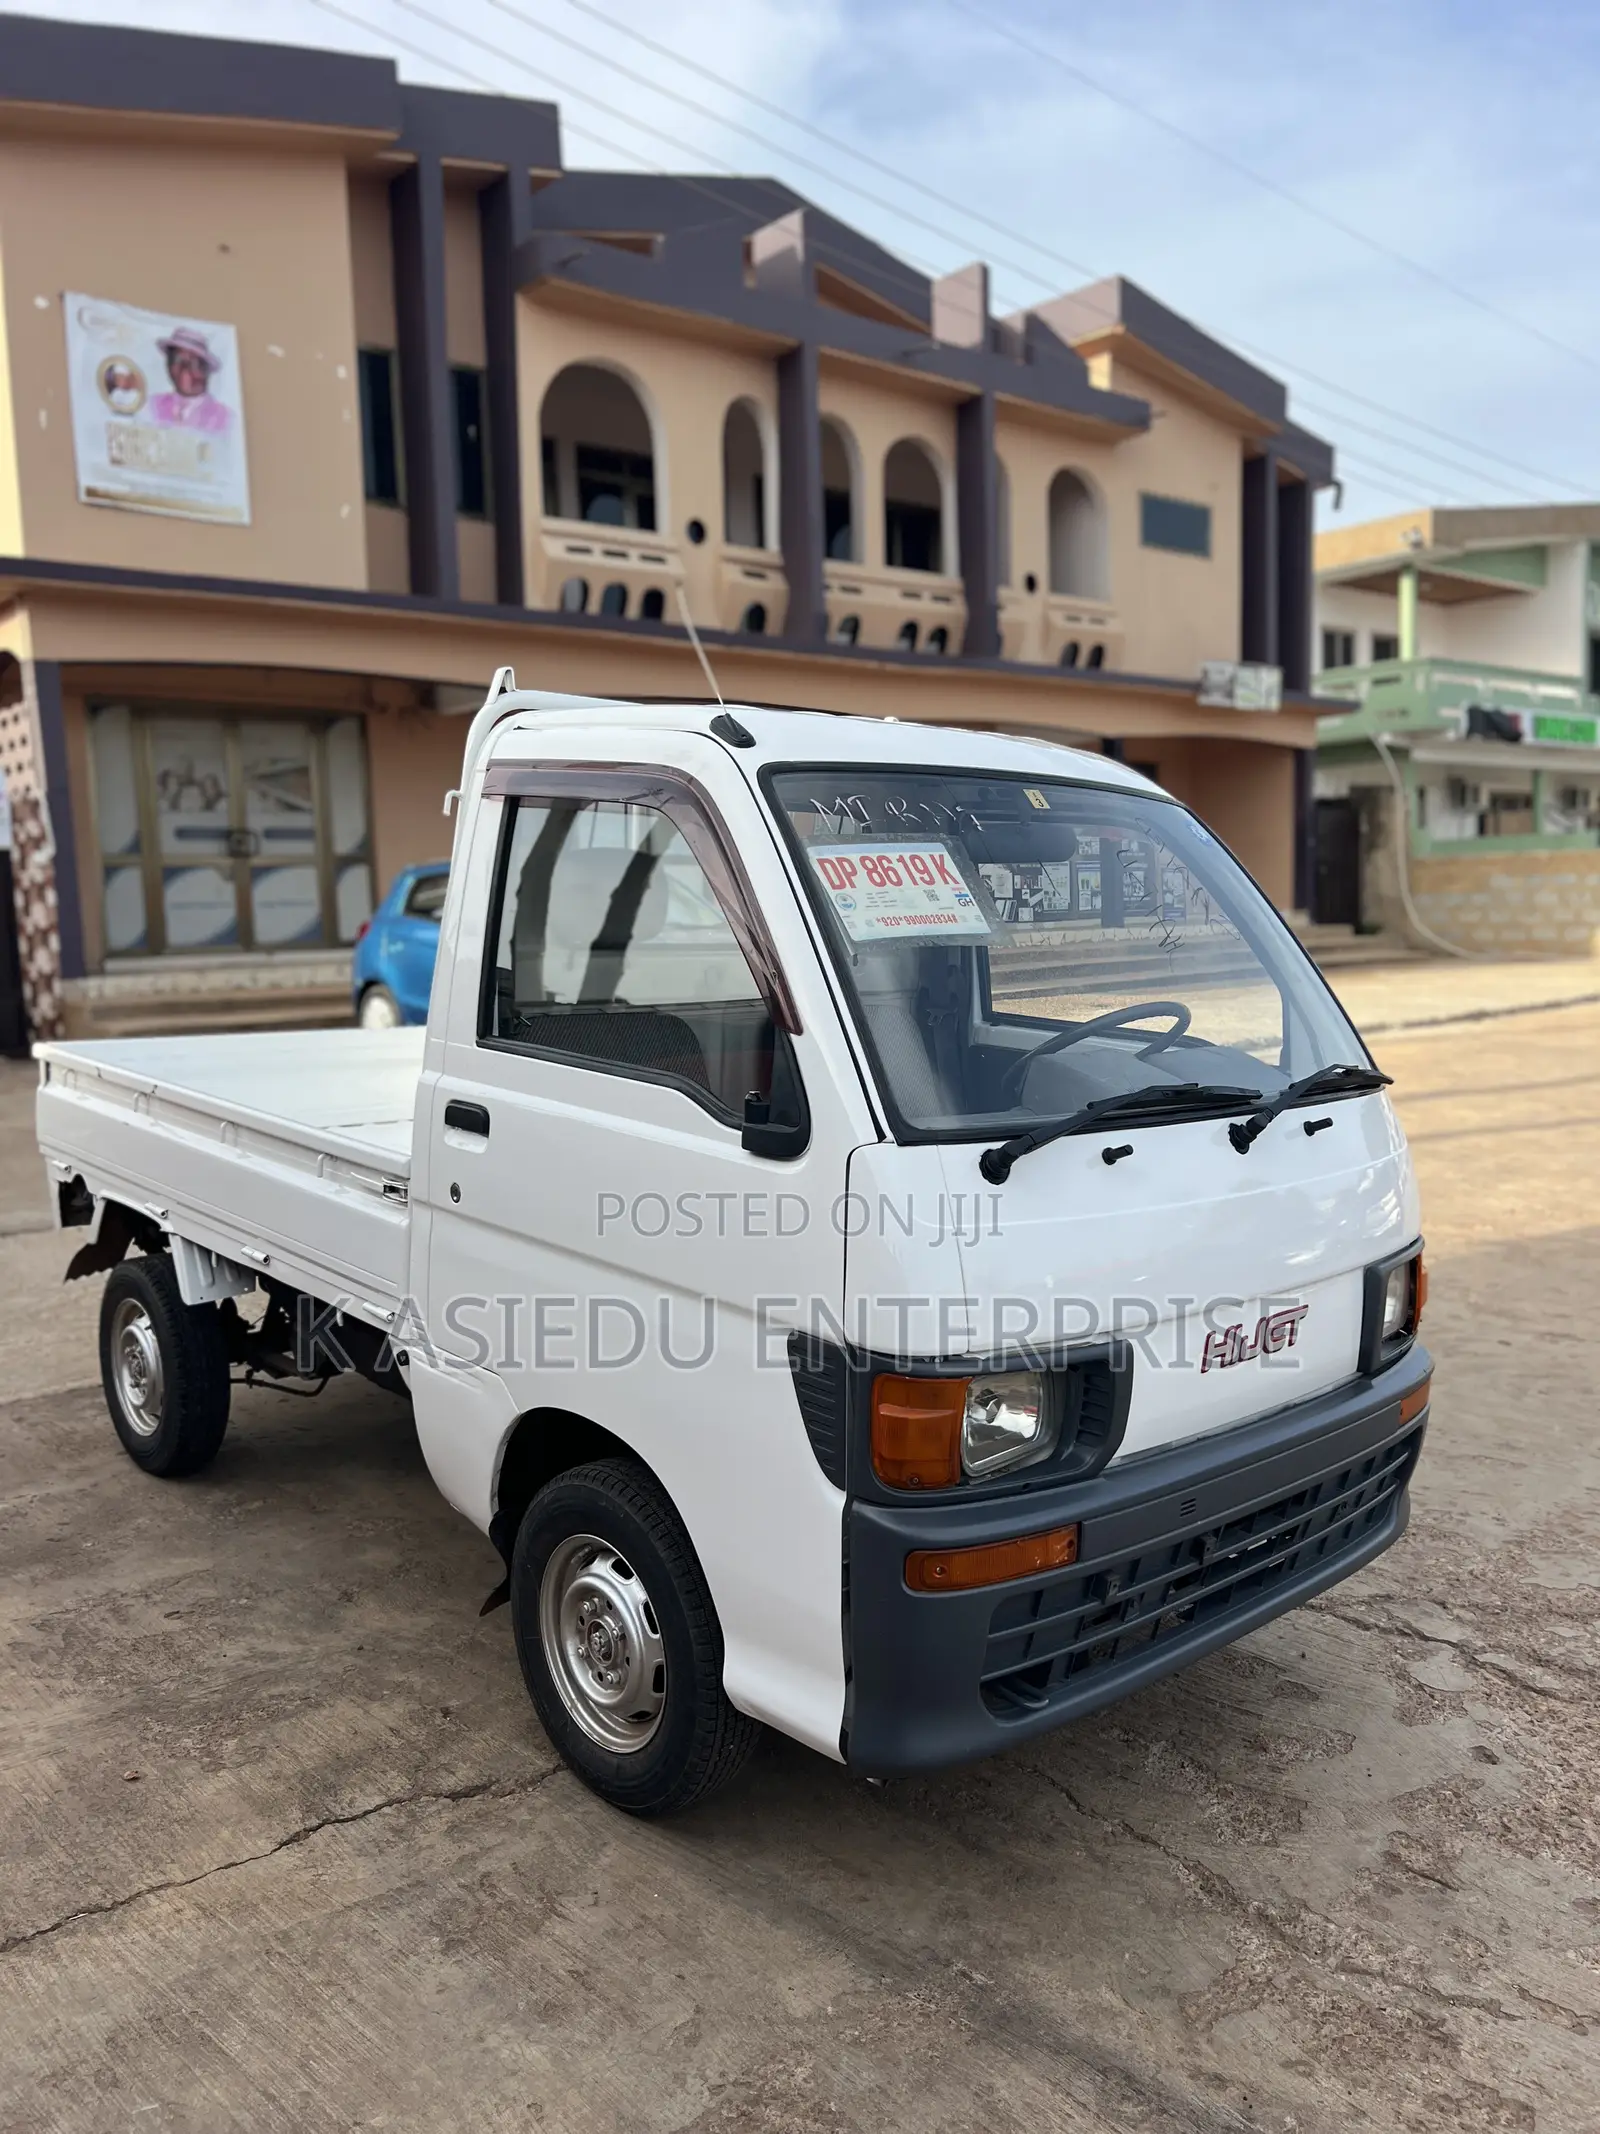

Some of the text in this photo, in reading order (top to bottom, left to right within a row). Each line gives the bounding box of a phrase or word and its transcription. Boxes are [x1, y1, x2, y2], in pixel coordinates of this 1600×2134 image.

[816, 854, 960, 890] DP 8619 K
[957, 898, 975, 907] GH
